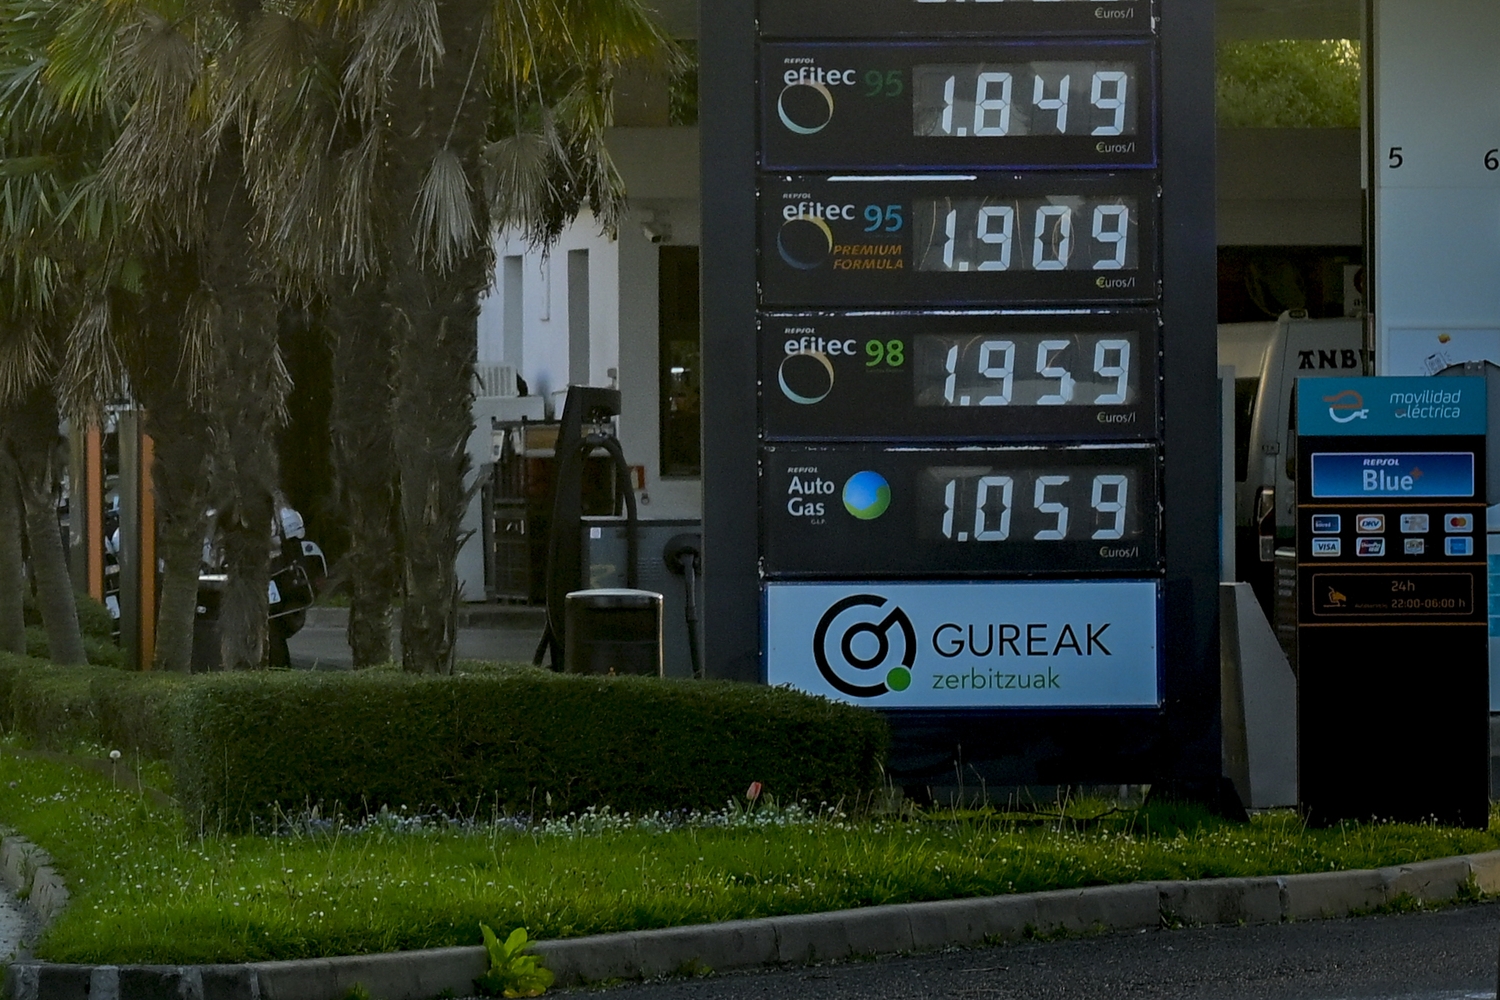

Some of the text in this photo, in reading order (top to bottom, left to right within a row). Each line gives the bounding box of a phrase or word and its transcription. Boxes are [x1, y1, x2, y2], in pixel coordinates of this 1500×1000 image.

[784, 66, 904, 97] efitec 95
[941, 71, 1128, 137] 1.849
[1389, 147, 1403, 169] 5
[1484, 148, 1499, 171] 6
[782, 201, 903, 232] efitec 95
[942, 204, 1129, 271] 1.909
[833, 244, 902, 256] PREMIUM
[833, 259, 904, 270] FORMULA
[784, 336, 904, 367] efitec 98
[944, 339, 1131, 406] 1.959
[1390, 389, 1461, 406] movilidad
[1394, 404, 1461, 419] eléctrica
[788, 475, 835, 495] Auto
[787, 496, 825, 516] Gas
[942, 475, 1129, 541] 1.059
[1391, 580, 1415, 592] 24h
[1459, 598, 1465, 608] h
[932, 623, 1112, 658] GUREAK
[932, 667, 1060, 690] zerbitzuak
